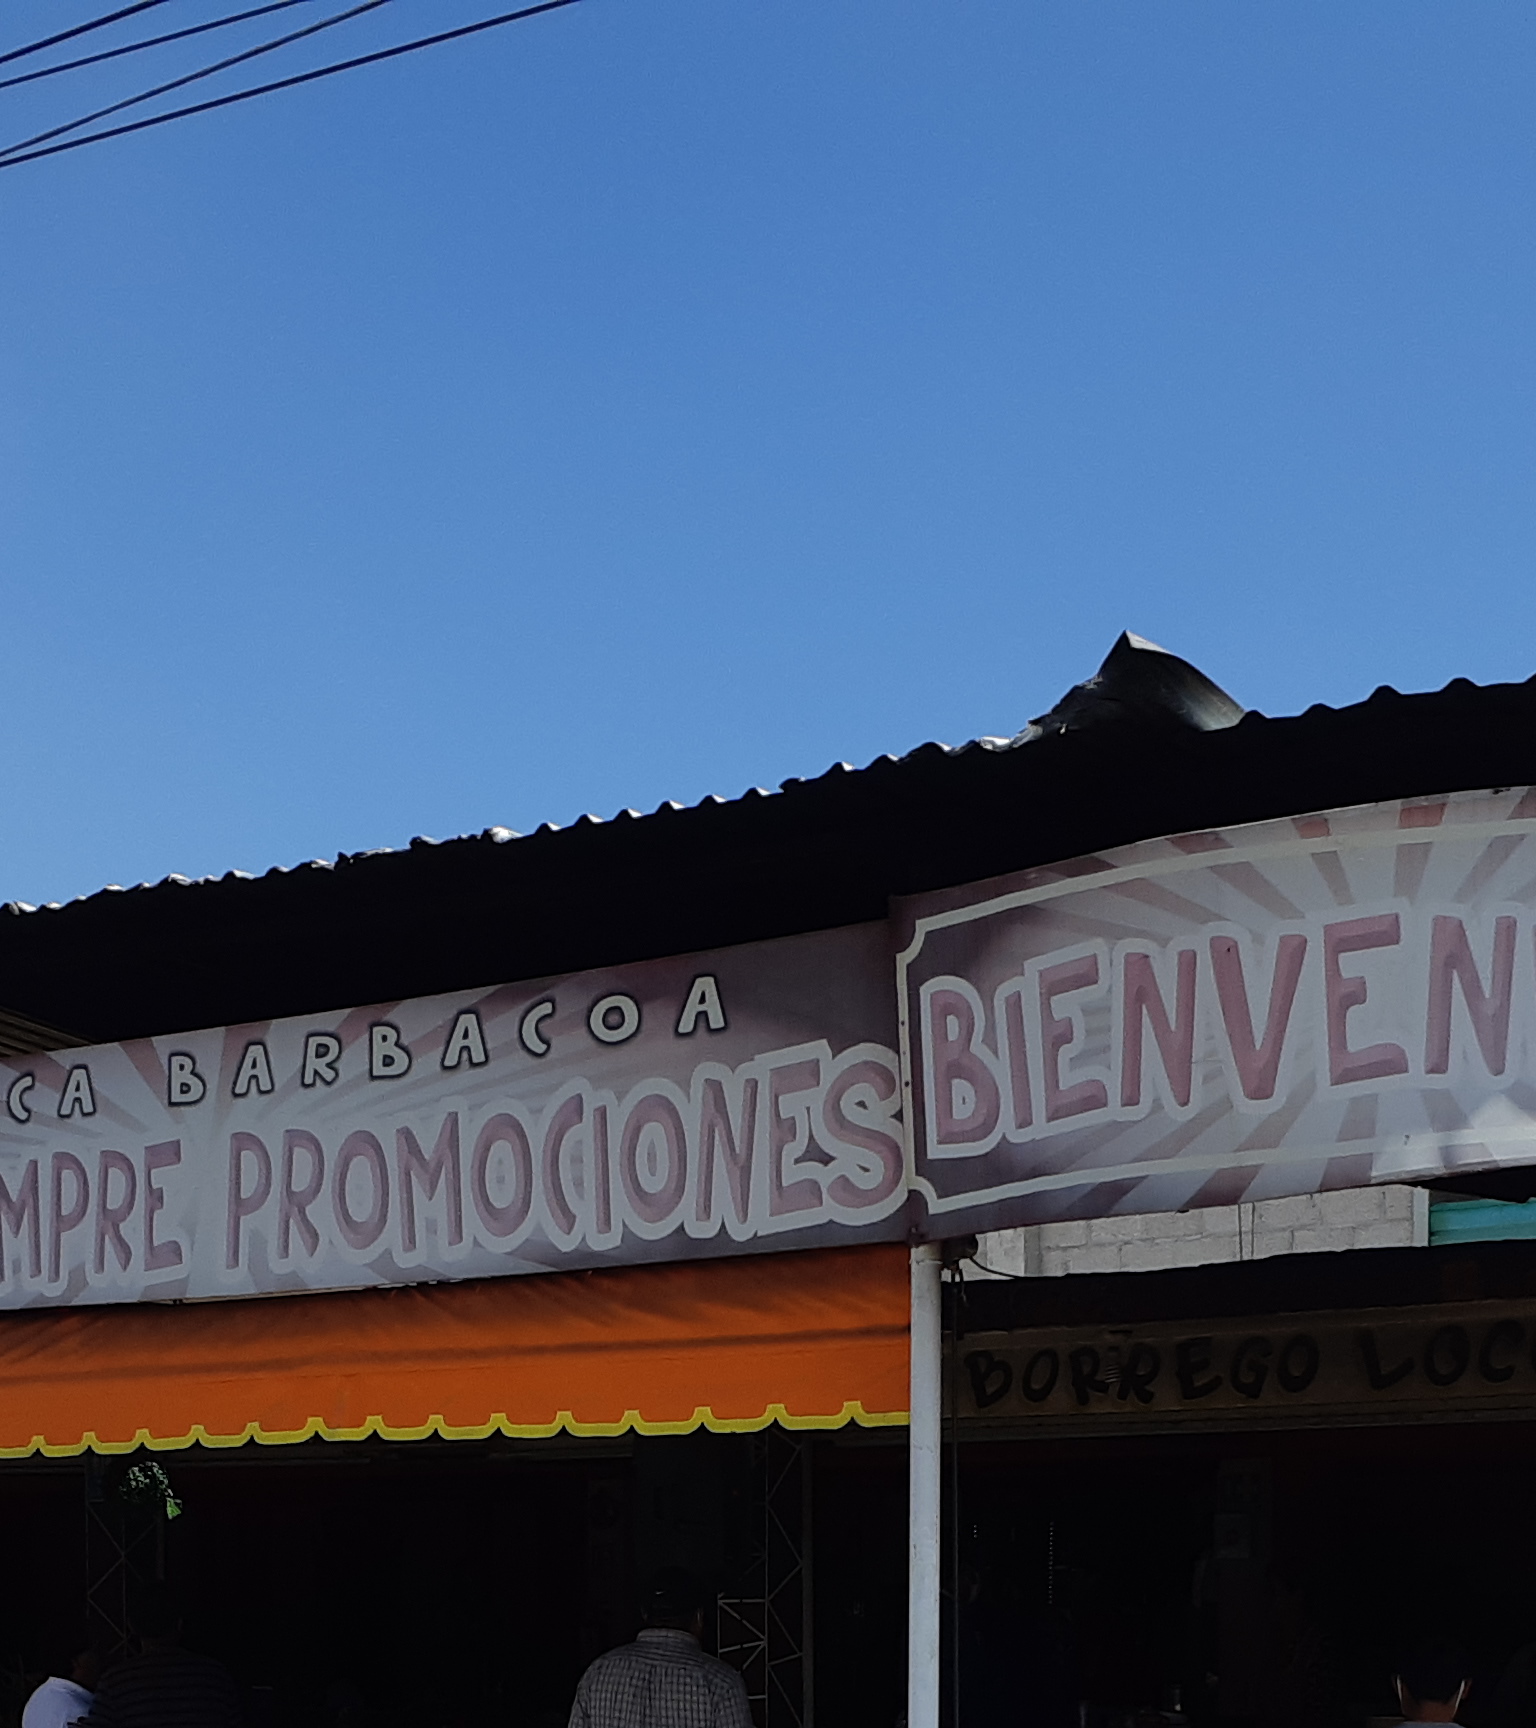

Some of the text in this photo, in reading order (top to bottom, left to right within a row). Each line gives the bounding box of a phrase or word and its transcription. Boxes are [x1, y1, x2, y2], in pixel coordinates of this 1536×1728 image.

[167, 975, 727, 1106] BARBACOA
[225, 1057, 904, 1270] PROMOCIONES
[965, 1334, 1320, 1408] BORREGO
